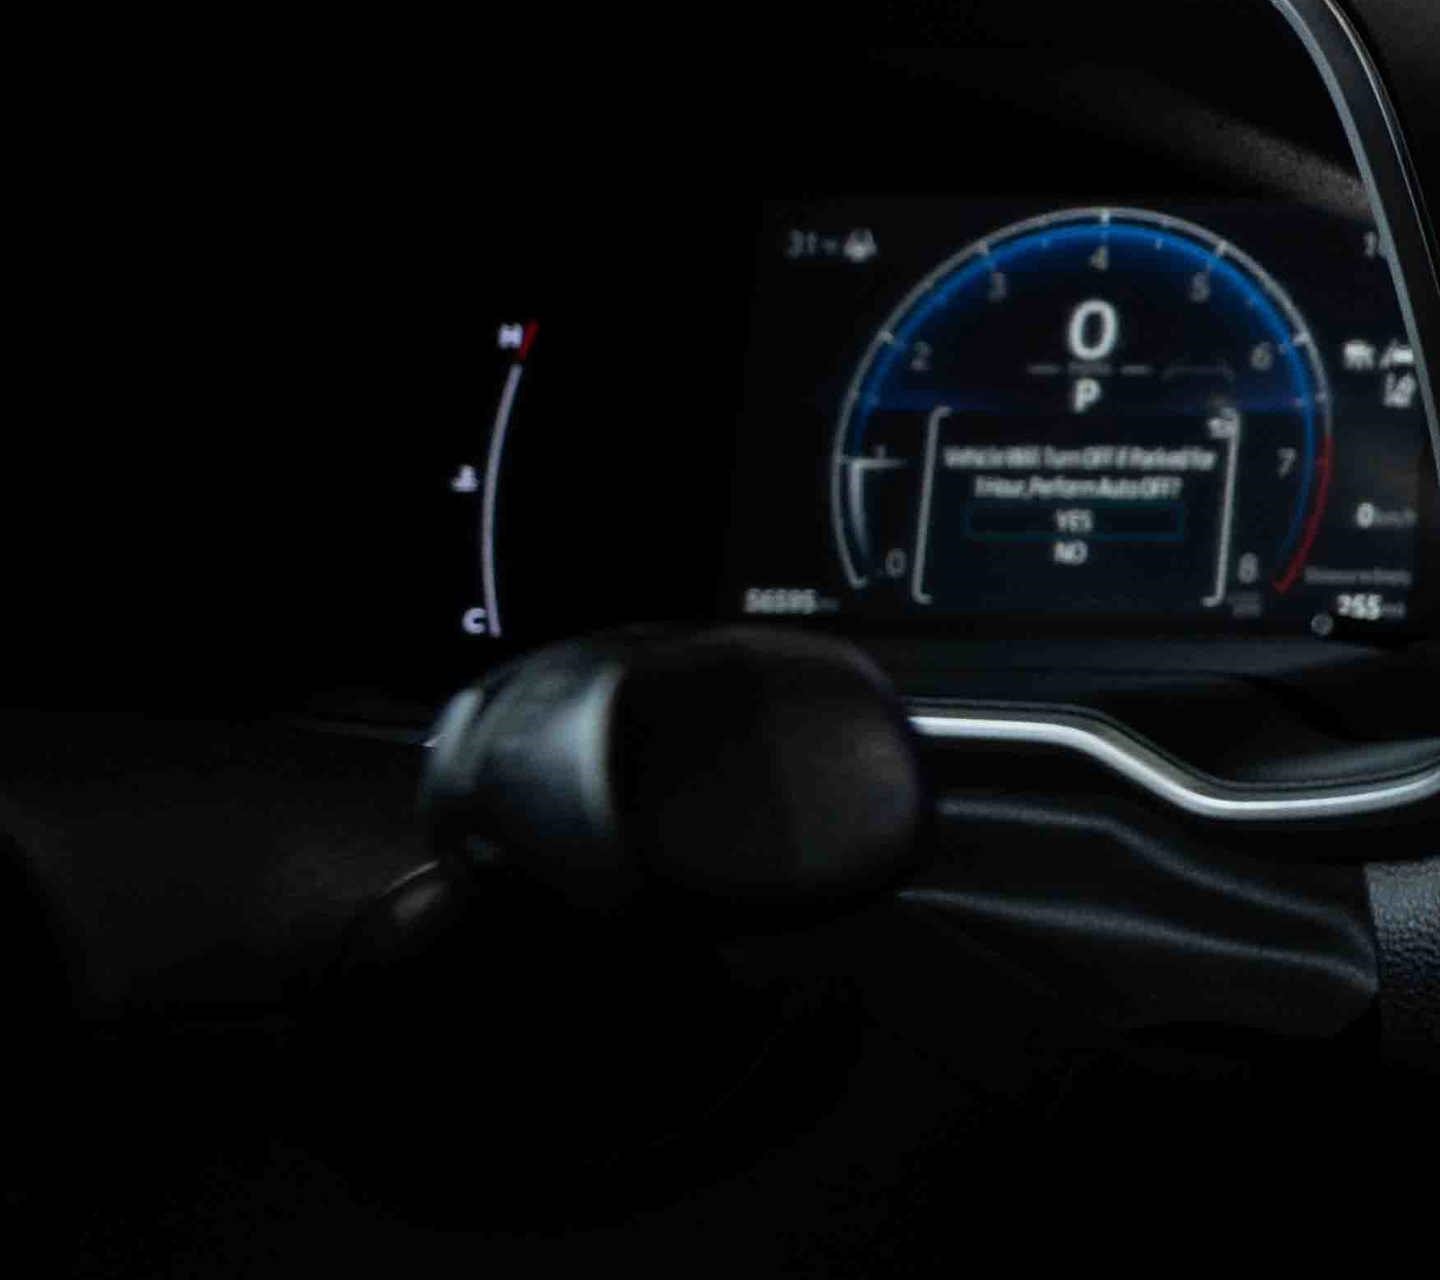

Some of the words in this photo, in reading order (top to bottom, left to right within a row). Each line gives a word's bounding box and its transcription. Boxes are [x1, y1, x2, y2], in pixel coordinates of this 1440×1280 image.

[1067, 301, 1118, 360] 0
[910, 341, 932, 371] 2
[1072, 379, 1100, 412] P
[1276, 447, 1297, 479] 7
[1055, 508, 1093, 533] YES
[1054, 539, 1089, 565] NO
[461, 606, 488, 636] C
